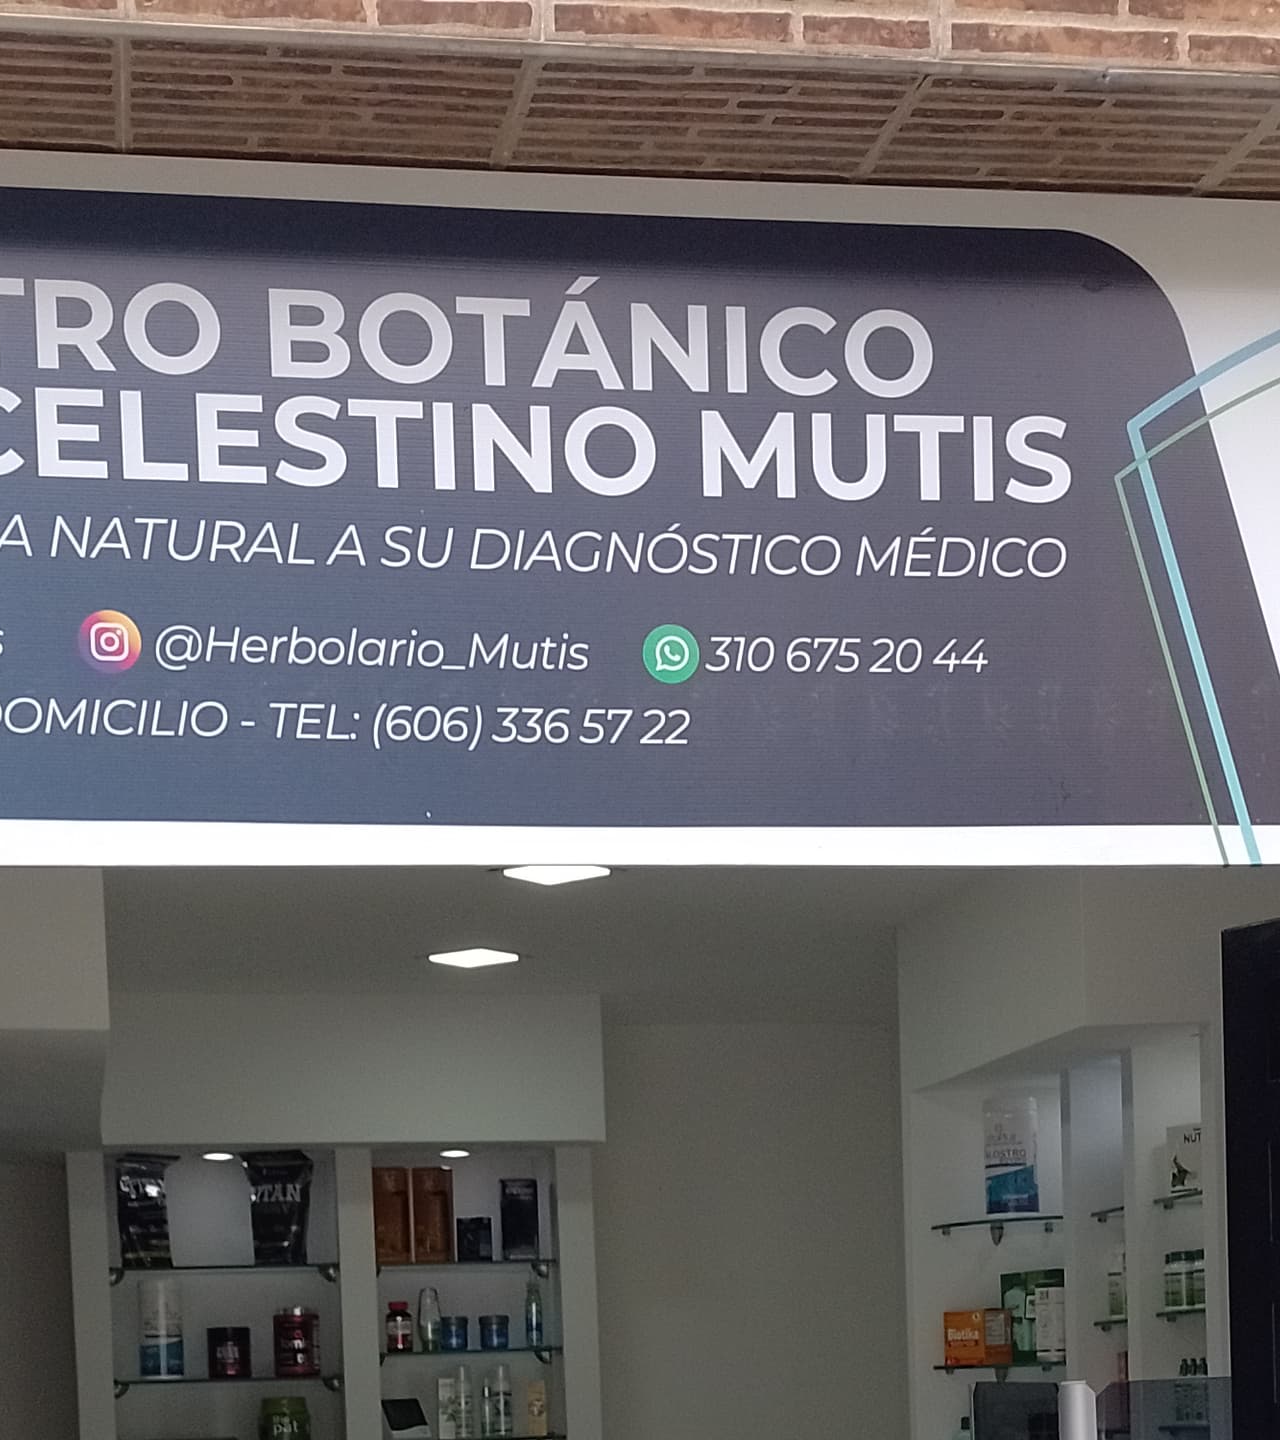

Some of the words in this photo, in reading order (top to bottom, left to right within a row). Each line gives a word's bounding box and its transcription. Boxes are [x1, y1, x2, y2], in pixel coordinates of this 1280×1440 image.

[268, 276, 934, 399] BOTÁNICO
[700, 410, 1073, 504] MUTIS
[51, 515, 315, 566] NATURAL
[326, 526, 367, 567] A
[381, 525, 455, 570] SU
[470, 523, 841, 577] DIAGNÓSTICO
[855, 527, 1067, 579] MÉDICO
[152, 624, 591, 672] @Herbolario_Mutis
[705, 635, 775, 672] 310
[785, 636, 860, 673] 675
[869, 637, 923, 674] 20
[932, 637, 989, 674] 44
[269, 702, 360, 741] TEL:
[371, 702, 484, 751] (606)
[491, 706, 571, 744] 336
[578, 708, 631, 744] 57
[639, 710, 691, 745] 22
